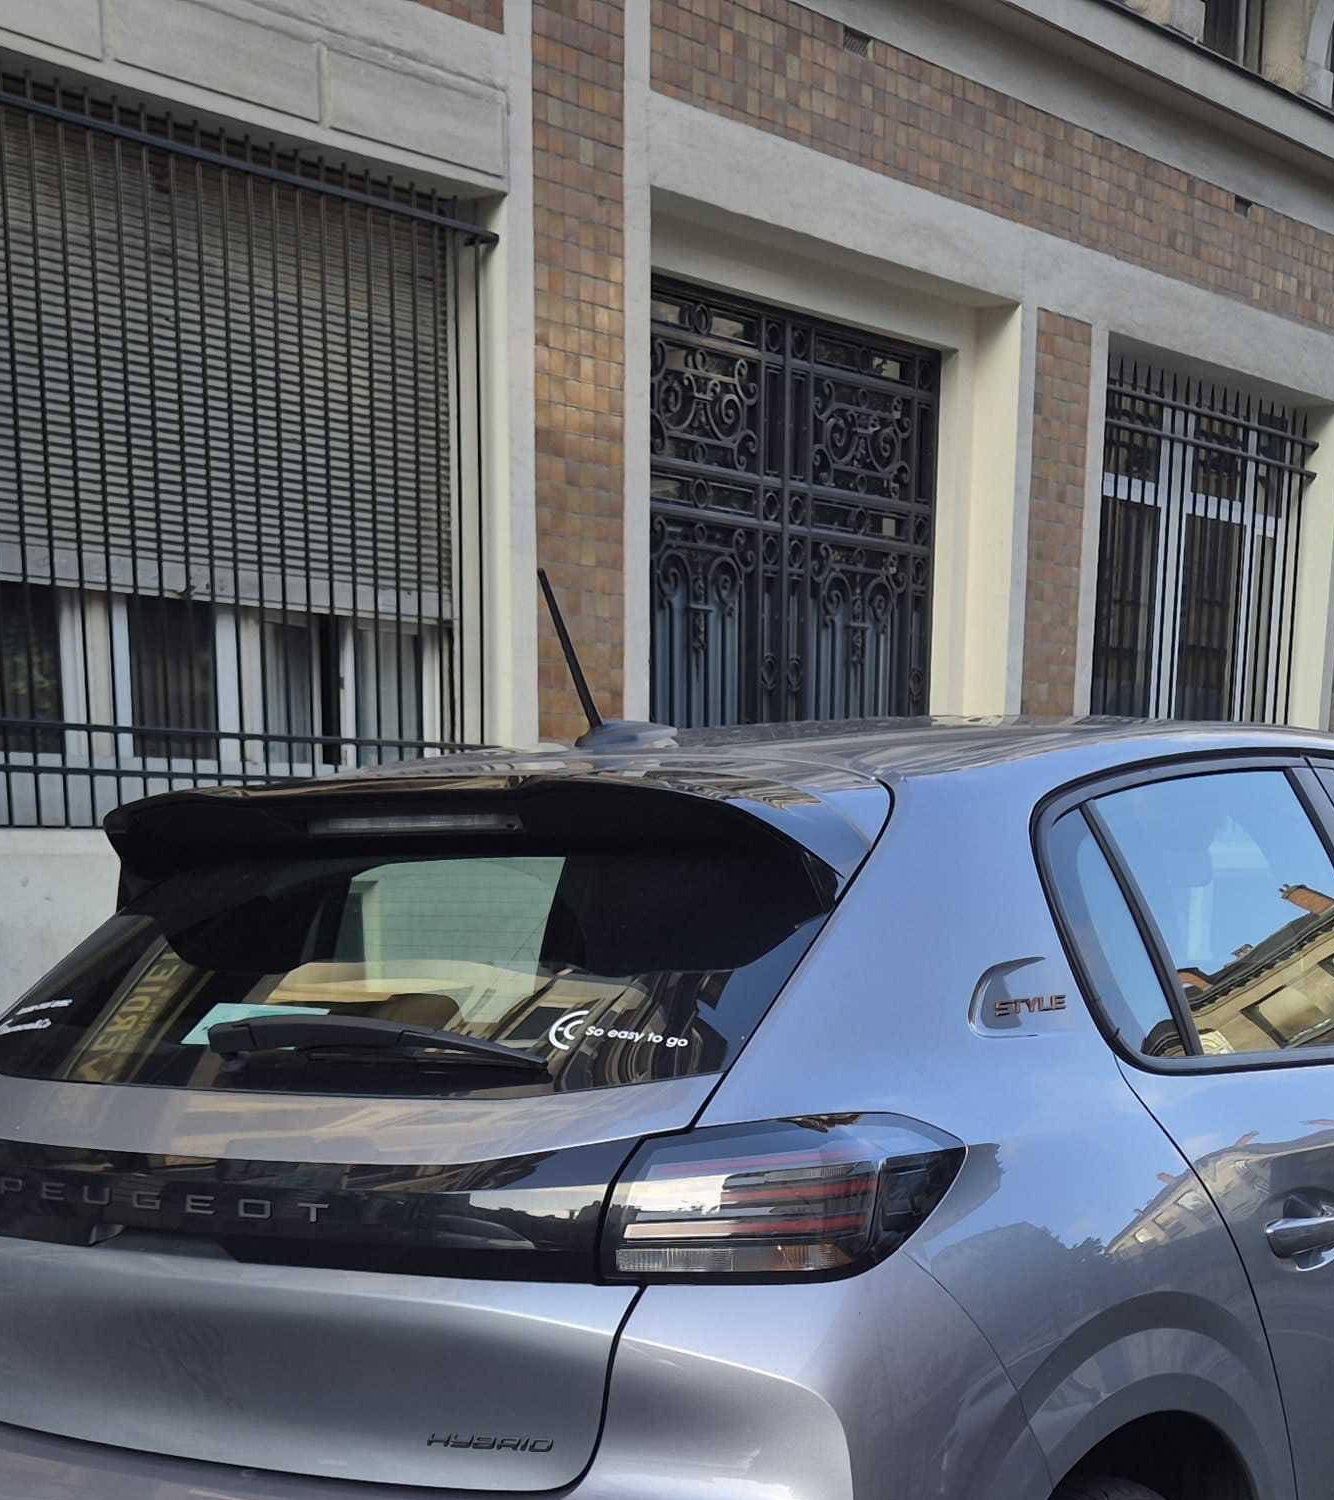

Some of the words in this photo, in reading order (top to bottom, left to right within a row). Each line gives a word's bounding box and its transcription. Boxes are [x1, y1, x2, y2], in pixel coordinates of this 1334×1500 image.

[994, 994, 1066, 1018] STYLE
[585, 1026, 605, 1037] So
[607, 1030, 644, 1042] easy
[647, 1032, 663, 1043] to
[666, 1036, 689, 1048] go
[0, 1177, 330, 1223] PEUGEOT
[427, 1433, 554, 1453] HYBRID
